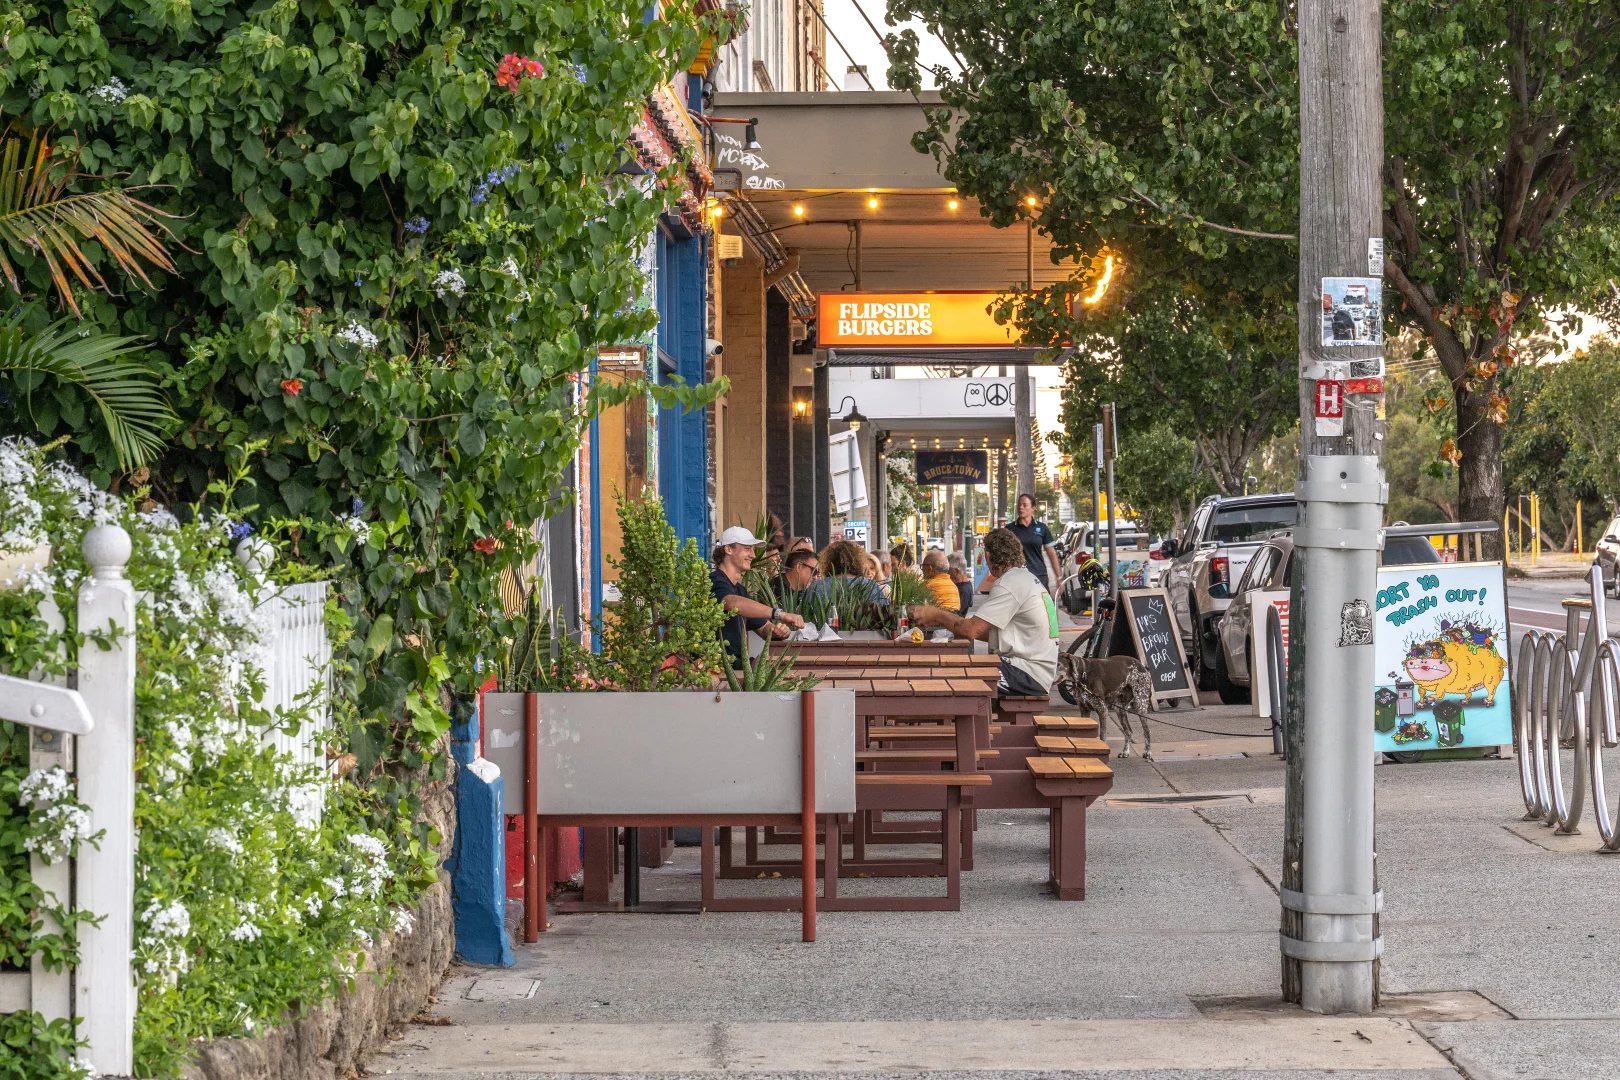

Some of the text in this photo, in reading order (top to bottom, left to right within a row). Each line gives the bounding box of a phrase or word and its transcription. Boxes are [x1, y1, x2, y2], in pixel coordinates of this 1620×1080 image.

[839, 303, 931, 319] FLIPSIDE
[837, 319, 933, 336] BURGERS
[1319, 385, 1339, 414] H
[923, 464, 981, 480] BRUCE TOWN
[1416, 574, 1440, 592] YA
[1385, 587, 1487, 627] TRASH OUT!
[1136, 614, 1157, 633] MRS
[1141, 631, 1170, 653] BROWN
[1150, 648, 1176, 669] BAR
[1160, 670, 1177, 682] OPEN
